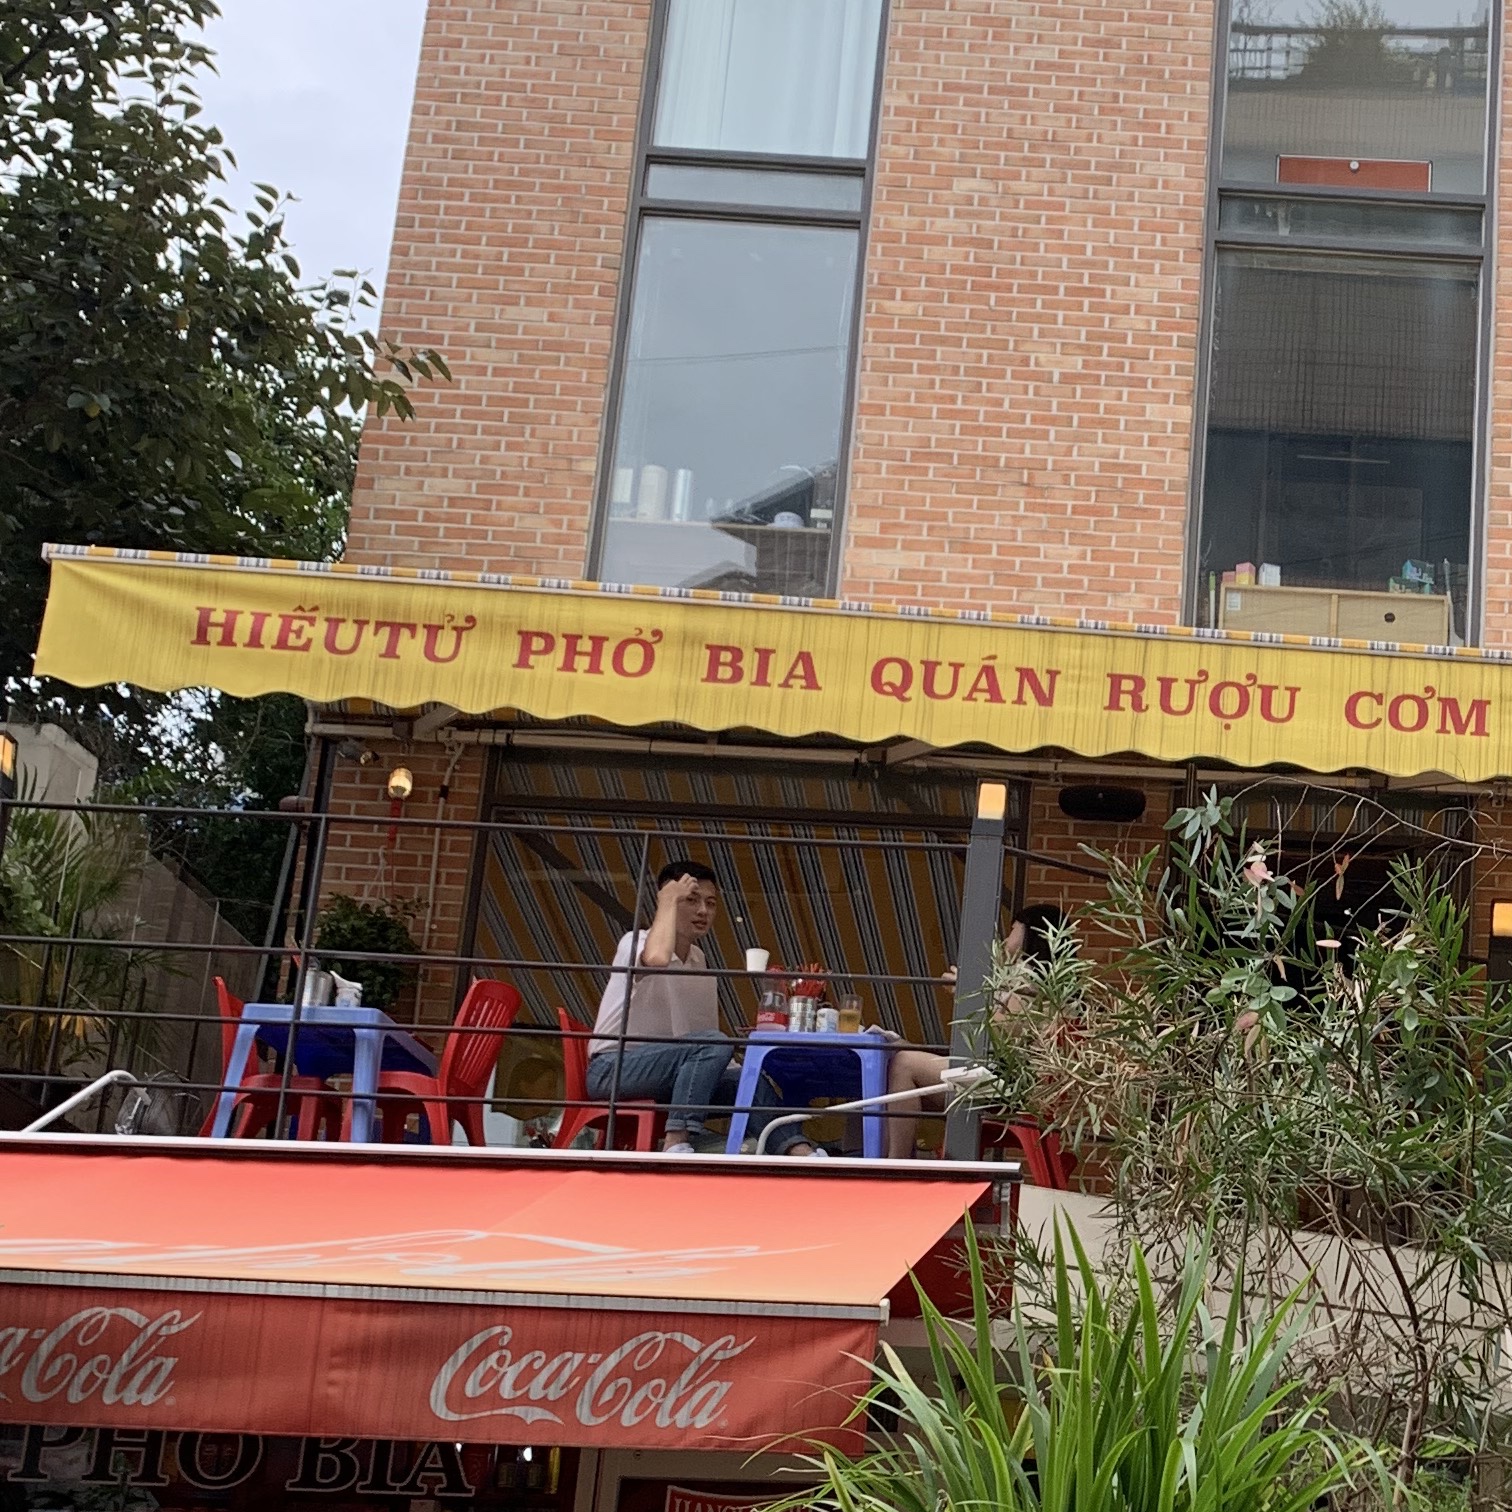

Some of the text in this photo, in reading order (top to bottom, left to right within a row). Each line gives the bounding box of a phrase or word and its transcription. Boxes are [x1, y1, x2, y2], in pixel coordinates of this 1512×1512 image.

[512, 627, 663, 678] PHỞ
[700, 643, 823, 691] BIA
[870, 655, 1061, 707] QUÁN
[1103, 667, 1300, 731] RƯỢU
[1344, 686, 1491, 737] CƠM
[429, 1324, 757, 1431] Coca-Cola
[286, 1437, 475, 1497] BIA
